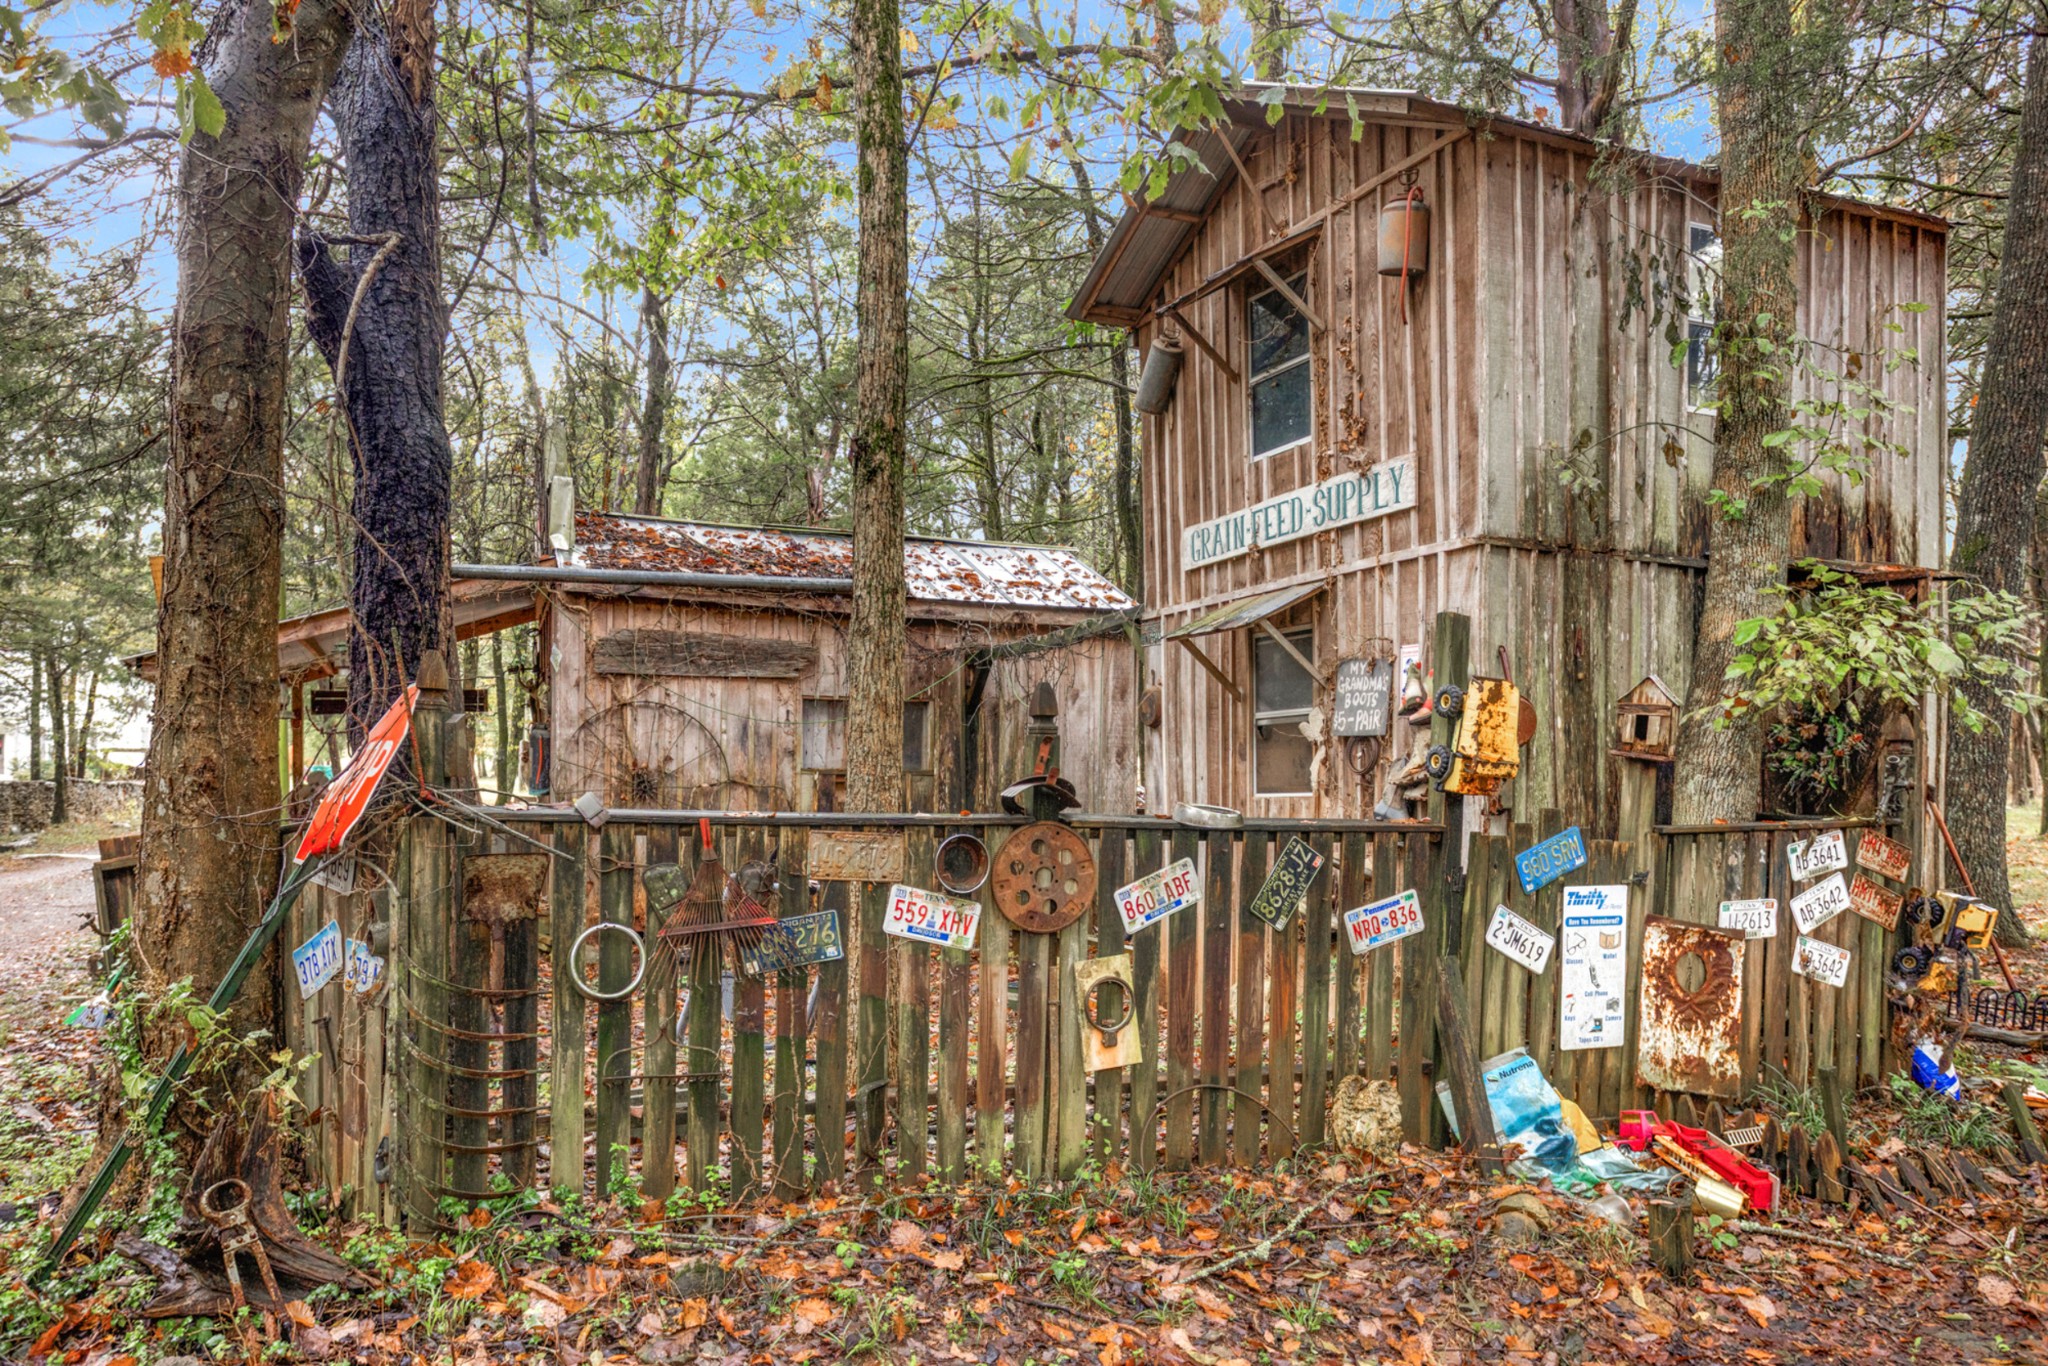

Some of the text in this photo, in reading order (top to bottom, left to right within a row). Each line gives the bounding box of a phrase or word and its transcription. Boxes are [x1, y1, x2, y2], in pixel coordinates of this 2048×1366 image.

[1350, 662, 1367, 675] MY
[1344, 691, 1379, 709] BOOTS
[1522, 835, 1582, 882] 980 SRM
[1142, 872, 1162, 887] TENN
[925, 893, 946, 904] TENN
[1124, 870, 1191, 920] 860 ABF
[893, 898, 974, 936] 559 XHV
[1363, 899, 1401, 916] Tennessee
[1352, 903, 1417, 942] NRQ 836
[299, 952, 321, 985] 378
[321, 935, 338, 970] ATX
[1498, 1060, 1535, 1080] Nutrena
